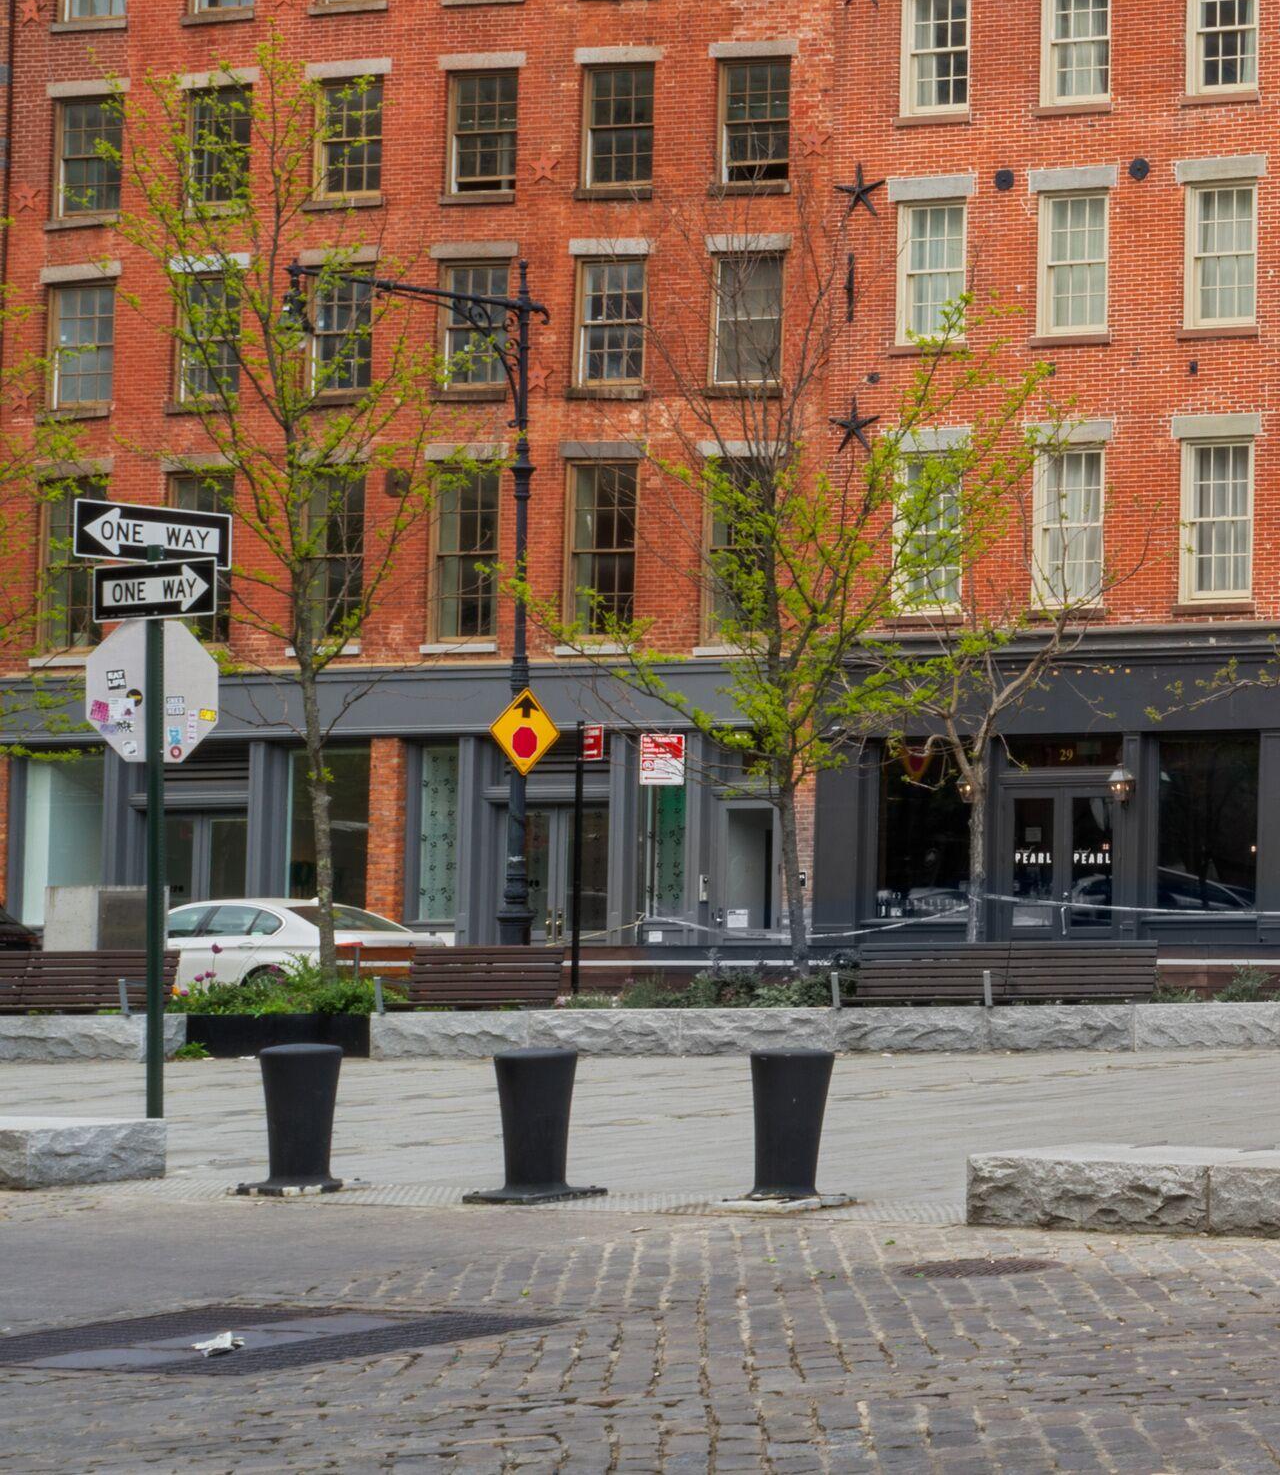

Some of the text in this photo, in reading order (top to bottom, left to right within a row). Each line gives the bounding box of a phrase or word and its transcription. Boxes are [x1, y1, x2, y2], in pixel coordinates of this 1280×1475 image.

[101, 520, 210, 550] ONE WAY
[112, 577, 197, 603] ONE WAY
[1060, 748, 1074, 761] 29
[1015, 852, 1052, 864] PEARL
[1073, 852, 1111, 864] PEARL
